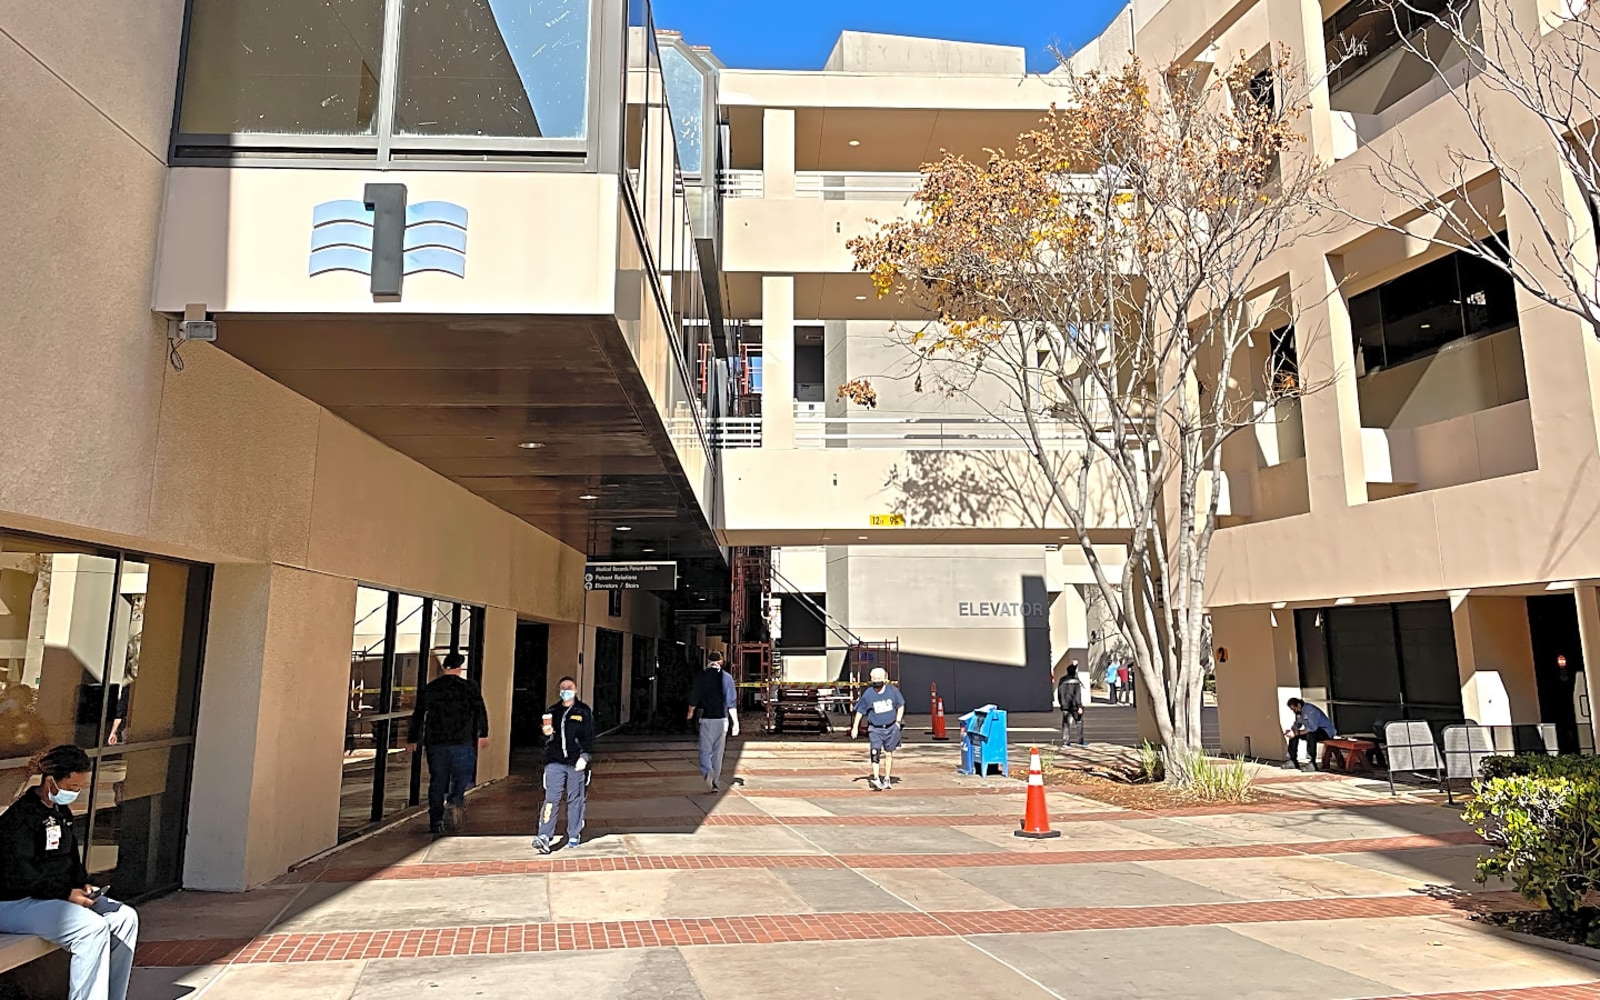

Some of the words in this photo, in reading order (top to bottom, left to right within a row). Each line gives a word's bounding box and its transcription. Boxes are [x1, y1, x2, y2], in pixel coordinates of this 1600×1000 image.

[363, 183, 408, 302] 1
[958, 602, 1043, 617] ELEVATOR
[1218, 647, 1226, 663] 2
